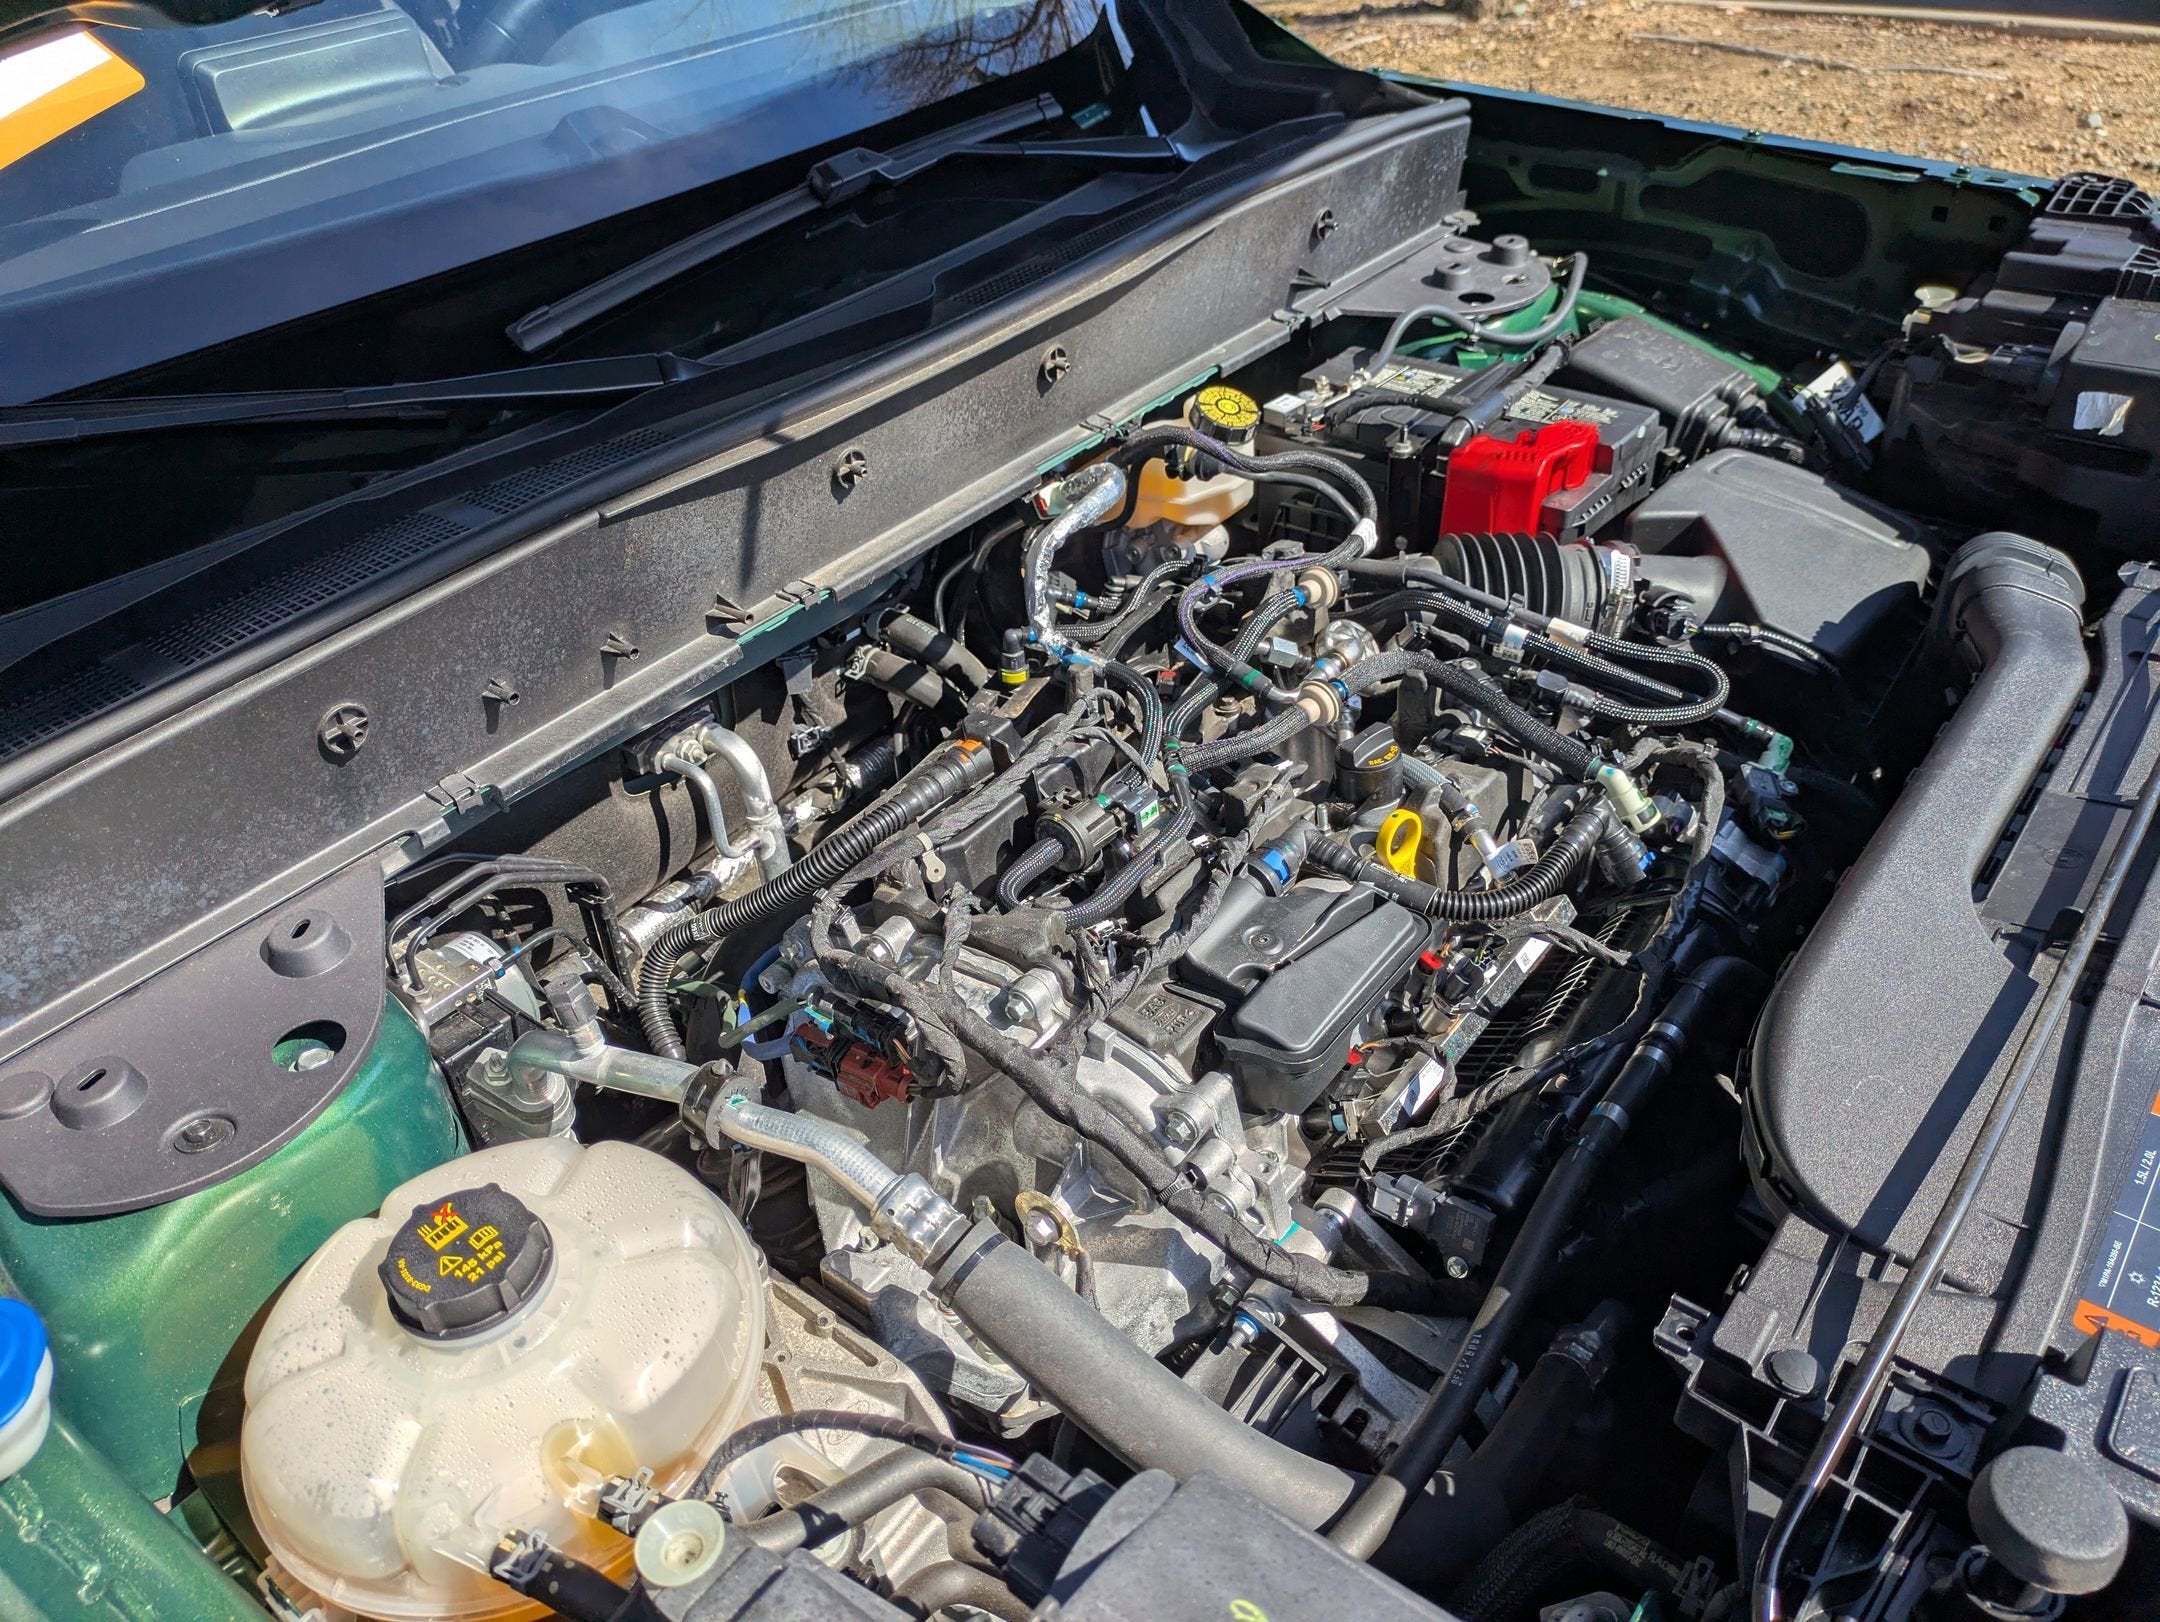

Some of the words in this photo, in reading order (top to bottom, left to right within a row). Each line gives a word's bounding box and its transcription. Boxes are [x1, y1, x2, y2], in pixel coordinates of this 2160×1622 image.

[2134, 1170, 2149, 1185] 1.5L
[2142, 1150, 2157, 1166] 2.0L
[454, 1259, 478, 1278] 145
[478, 1241, 503, 1260] kPa
[467, 1267, 485, 1283] 21
[486, 1252, 506, 1271] psi
